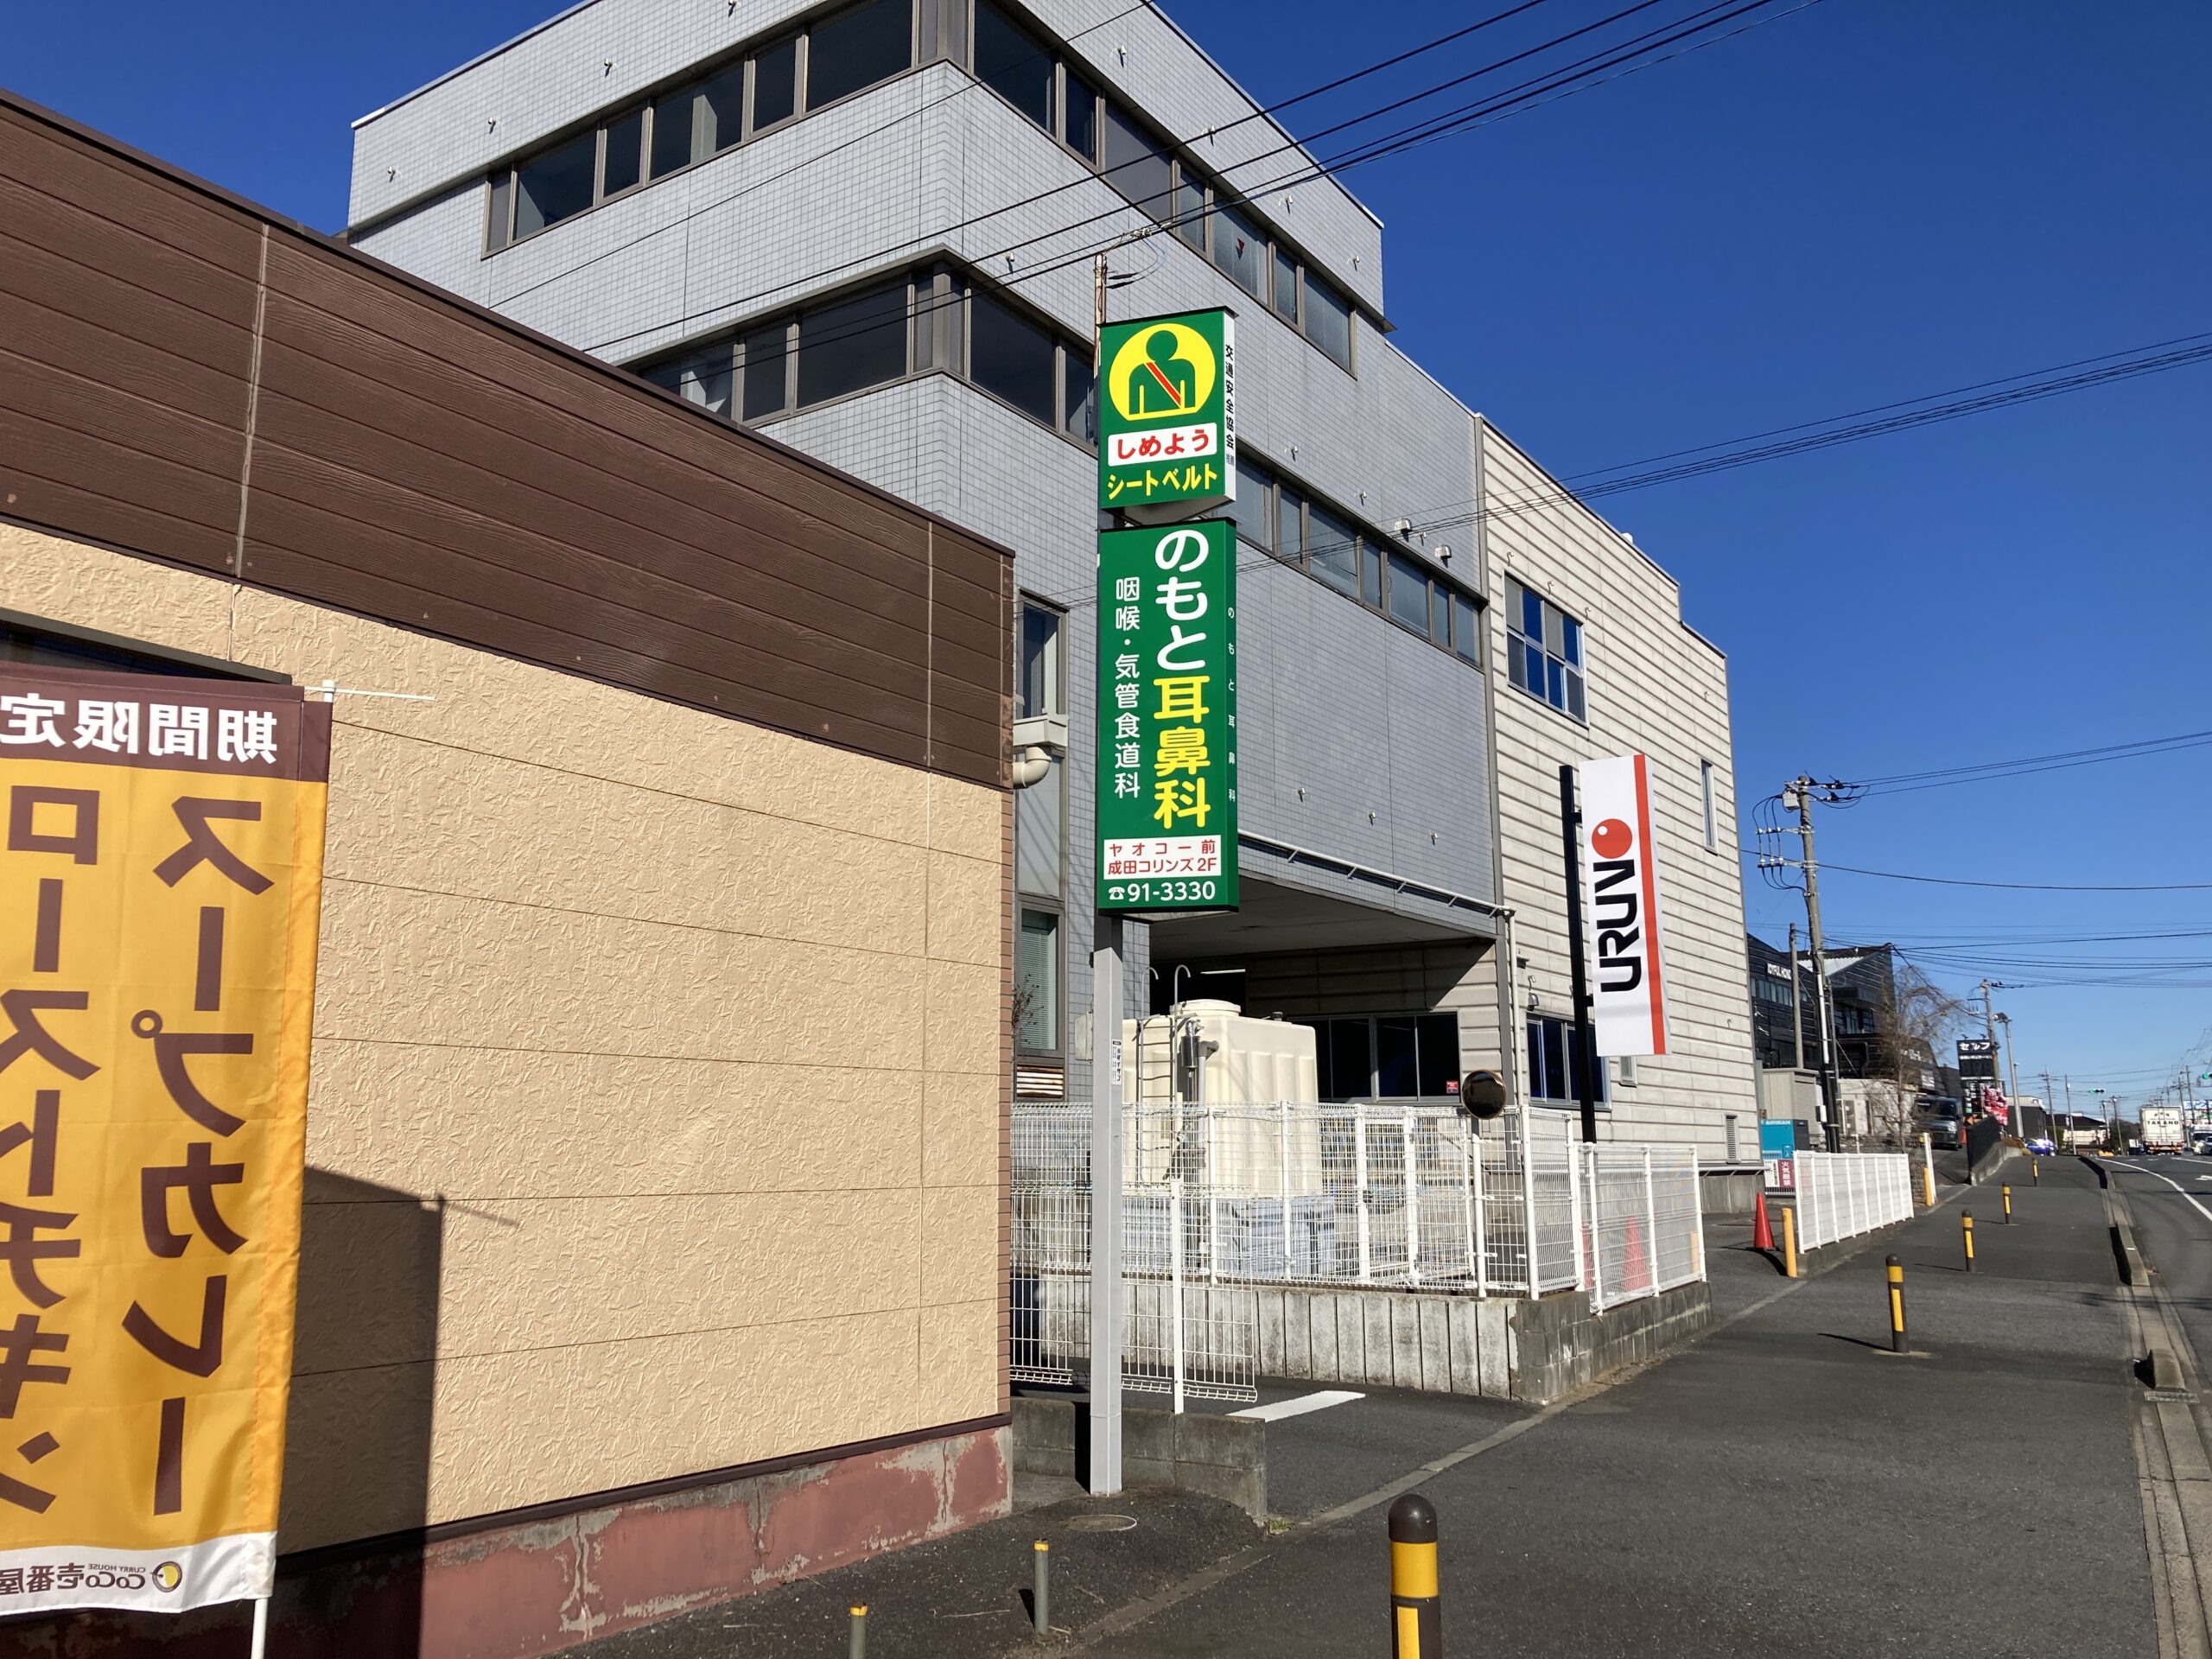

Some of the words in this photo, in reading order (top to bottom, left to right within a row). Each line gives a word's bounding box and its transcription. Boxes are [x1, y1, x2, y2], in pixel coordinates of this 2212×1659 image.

[1224, 344, 1235, 450] 交通安全協会
[1117, 429, 1209, 460] しめよう
[1108, 463, 1217, 500] シートベルト
[1115, 576, 1141, 799] 咽喉・気管食道科
[1154, 529, 1211, 830] のもと耳鼻科
[1227, 607, 1236, 803] のもと耳鼻科
[1109, 839, 1217, 857] ヤオコー前
[1127, 880, 1216, 902] 91-3330
[1959, 1042, 1991, 1051] セルフ
